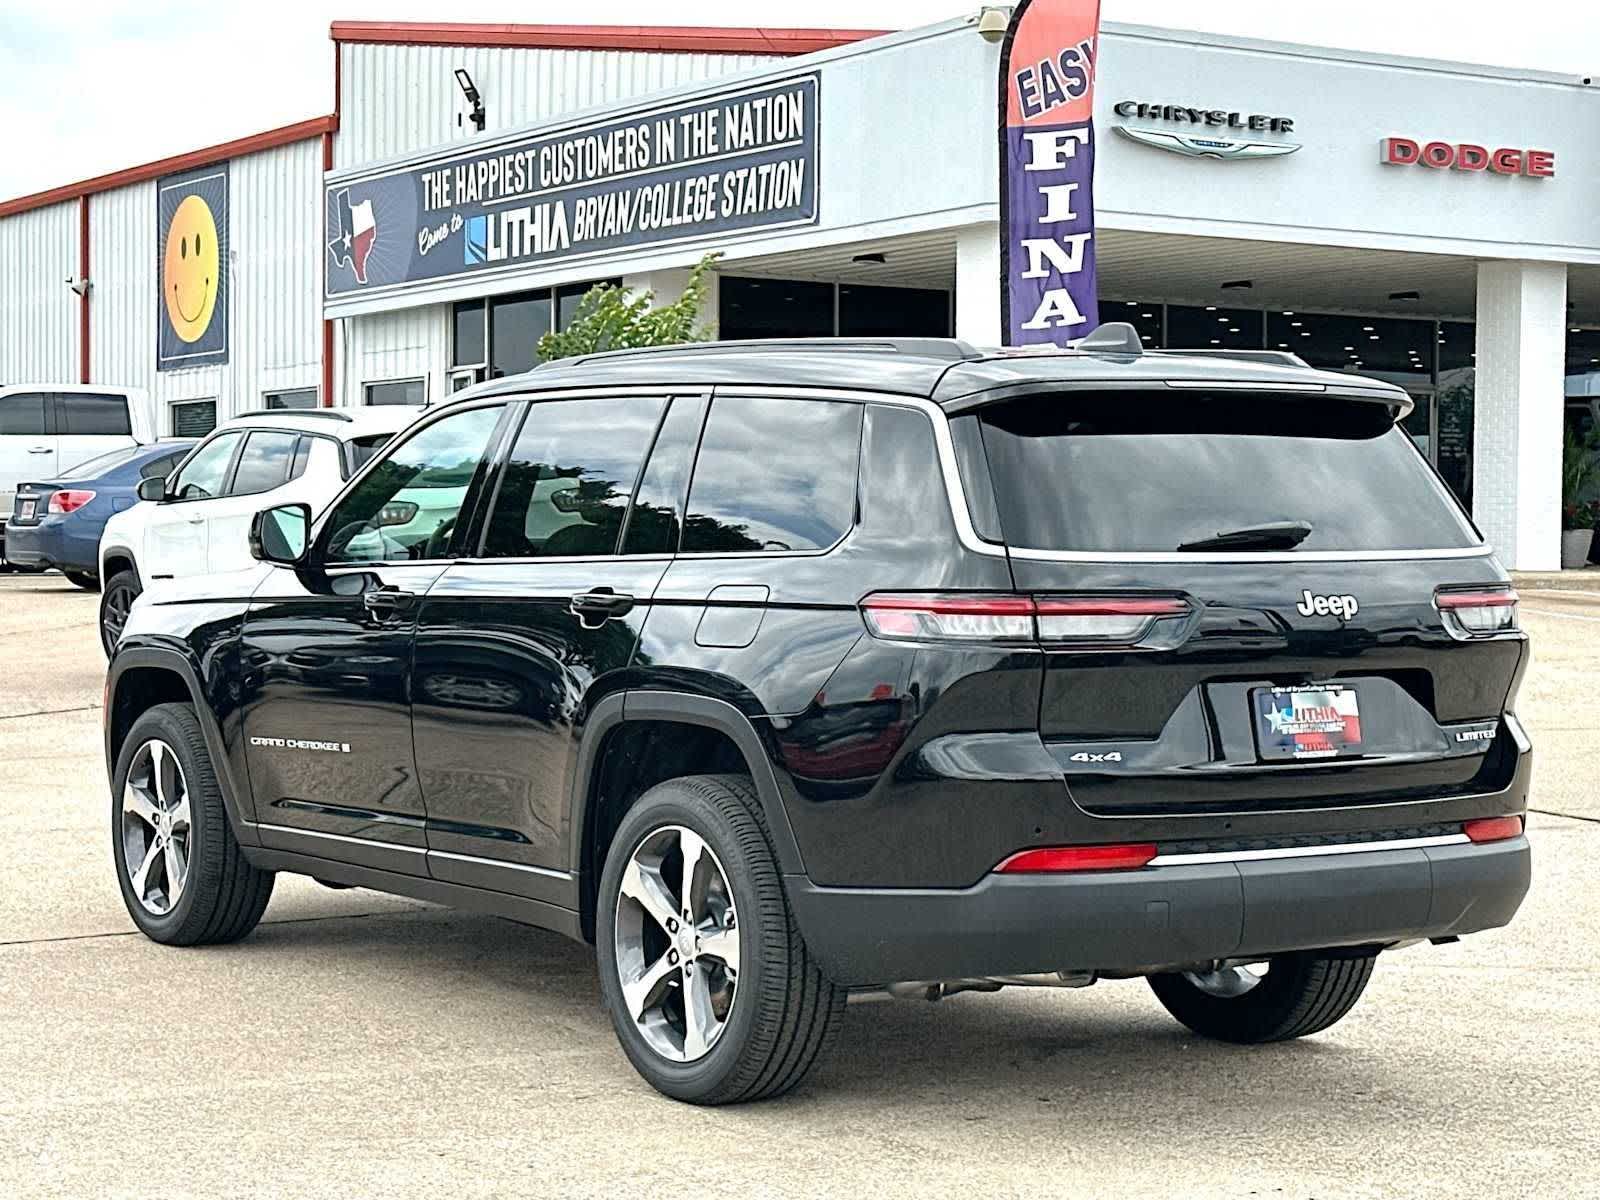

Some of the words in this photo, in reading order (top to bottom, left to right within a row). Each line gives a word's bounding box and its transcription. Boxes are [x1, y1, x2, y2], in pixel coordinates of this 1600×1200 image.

[1114, 100, 1294, 133] CHRYSLER
[422, 168, 452, 211] THE
[456, 149, 536, 205] HAPPIEST
[540, 123, 650, 188] CUSTOMERS
[655, 118, 675, 165] IN
[680, 108, 719, 159] THE
[725, 89, 804, 151] NATION
[1379, 136, 1555, 178] DODGE
[418, 223, 449, 256] Come
[450, 212, 464, 233] to
[486, 200, 570, 262] LITHIA
[573, 173, 720, 242] BRYAN/COLLEGE
[721, 158, 805, 218] STATION
[1021, 127, 1092, 350] FINA
[1296, 589, 1359, 620] Jeep
[1295, 706, 1341, 722] LITHIA
[286, 739, 340, 752] CHEROKEE
[1455, 730, 1496, 742] LIMITED
[1069, 752, 1122, 762] 4x4
